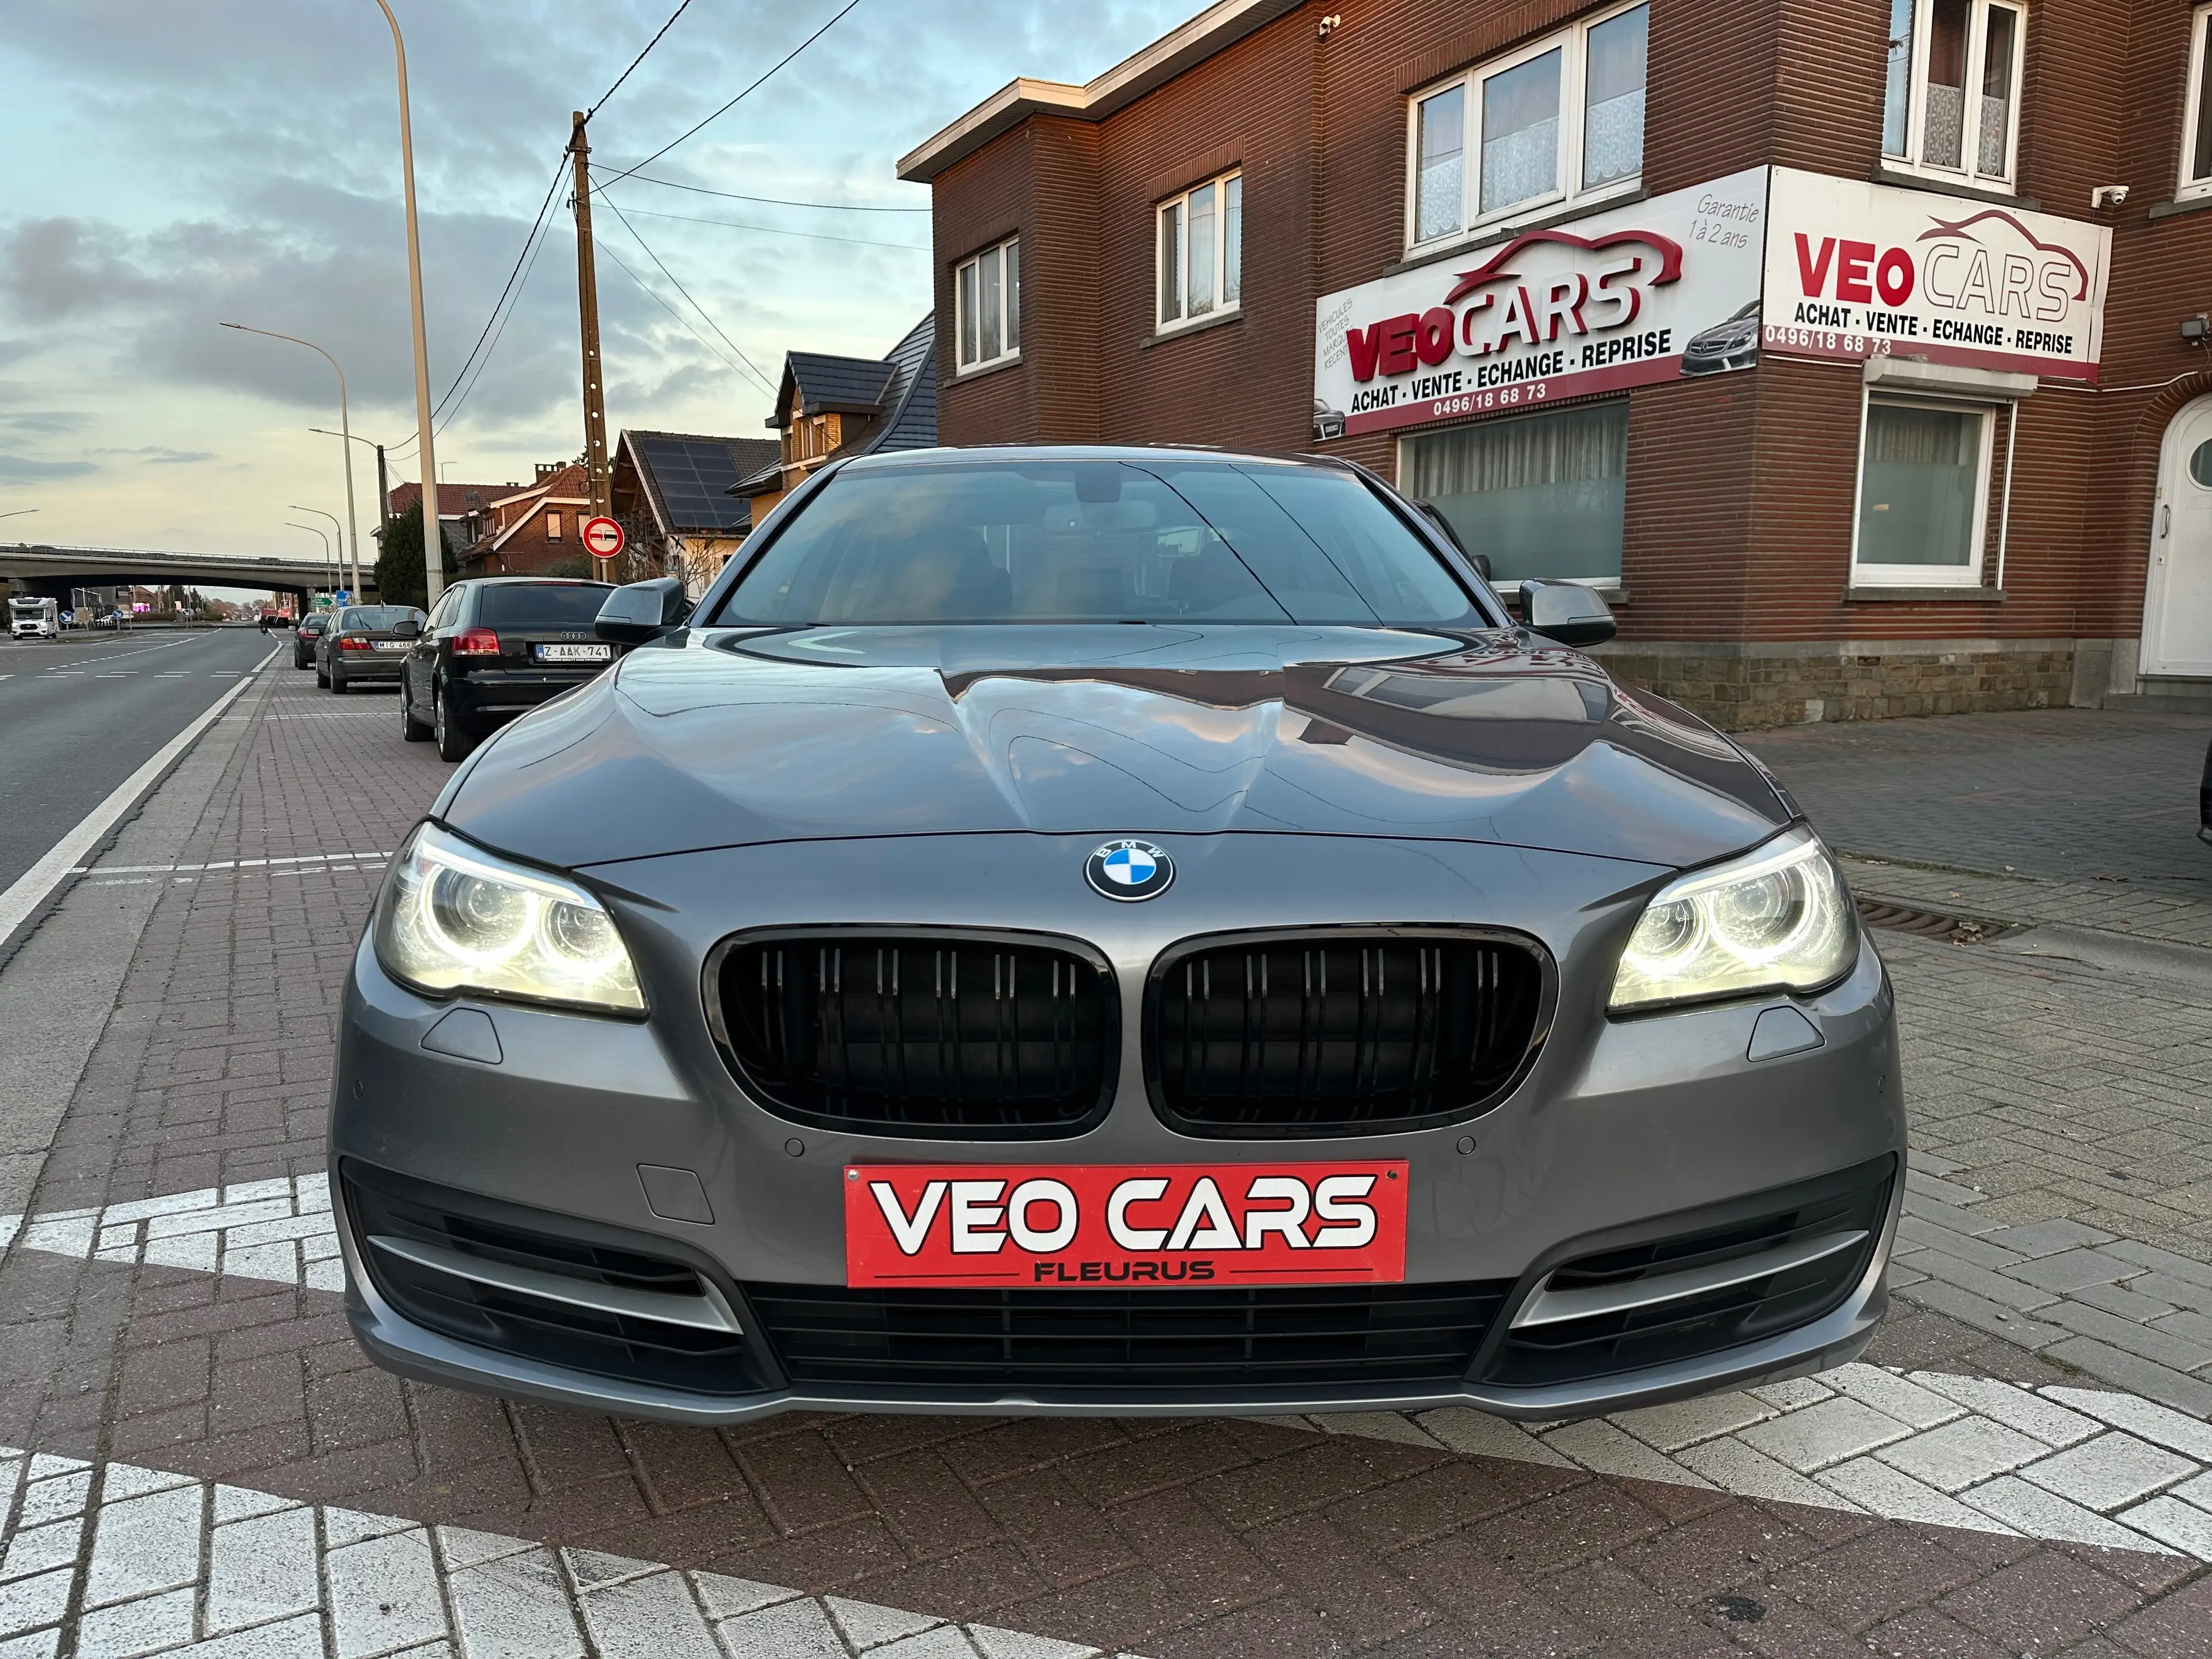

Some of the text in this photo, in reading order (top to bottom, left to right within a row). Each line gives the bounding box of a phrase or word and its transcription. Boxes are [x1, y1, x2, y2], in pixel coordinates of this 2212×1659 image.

[1698, 194, 1759, 222] Garantie
[1689, 219, 1748, 248] 1 à 2 ans
[1794, 232, 2071, 323] VEO CARS
[1318, 297, 1353, 333] VEHICULES
[1325, 315, 1350, 341] TOUTES
[1346, 257, 1641, 382] VEO CARS
[1794, 302, 2073, 354] ACHAT VENTE ECHANGE REPRISE
[1323, 324, 1354, 357] MARQU
[1765, 325, 1891, 355] 0496/18 68 73
[1324, 342, 1349, 370] RECENT
[1351, 328, 1672, 413] ACHAT VENTE ECHANGE REPRISE
[1433, 383, 1546, 415] 0496/18 68 73
[544, 646, 608, 657] Z-AAK-741
[1096, 841, 1164, 858] BMW
[869, 1175, 1378, 1257] VEO CARS
[1034, 1260, 1215, 1282] FLEURUS
